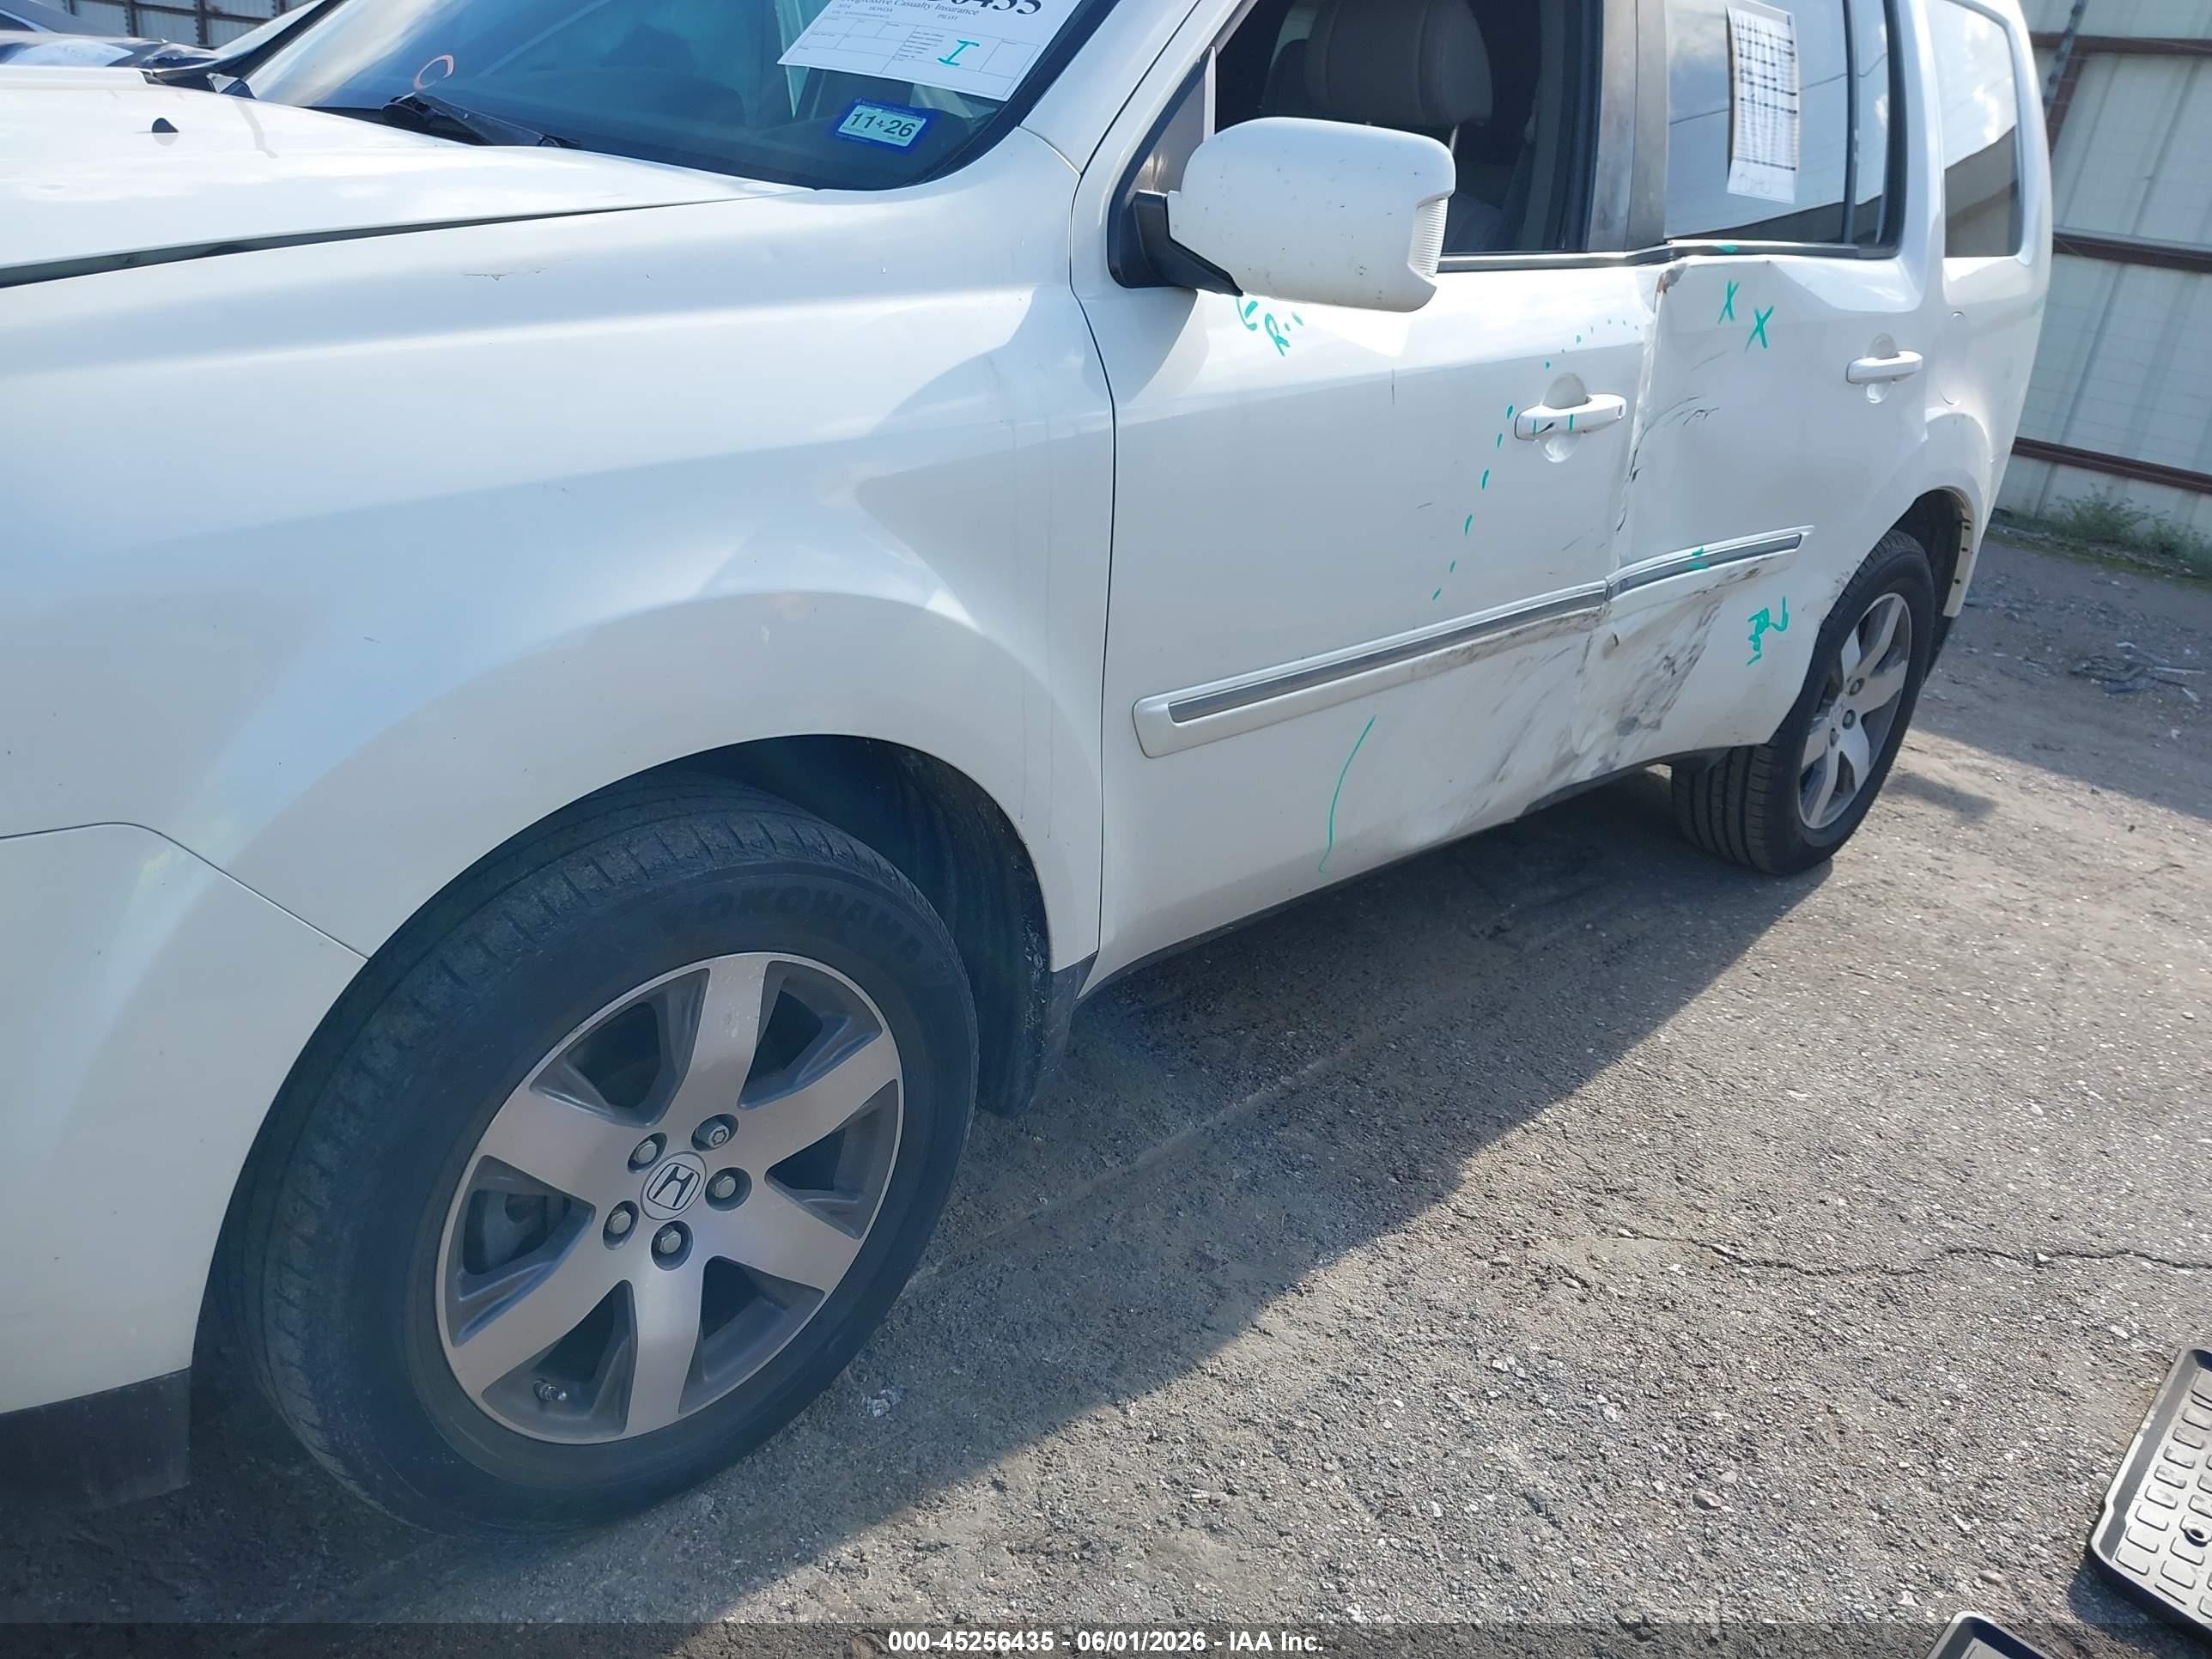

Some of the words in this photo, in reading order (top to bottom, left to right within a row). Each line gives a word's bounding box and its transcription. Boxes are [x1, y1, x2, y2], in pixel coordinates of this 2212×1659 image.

[894, 0, 933, 10] Casualty
[934, 3, 979, 15] Insurance
[883, 119, 916, 137] 26
[653, 884, 926, 960] YOKOHAMA
